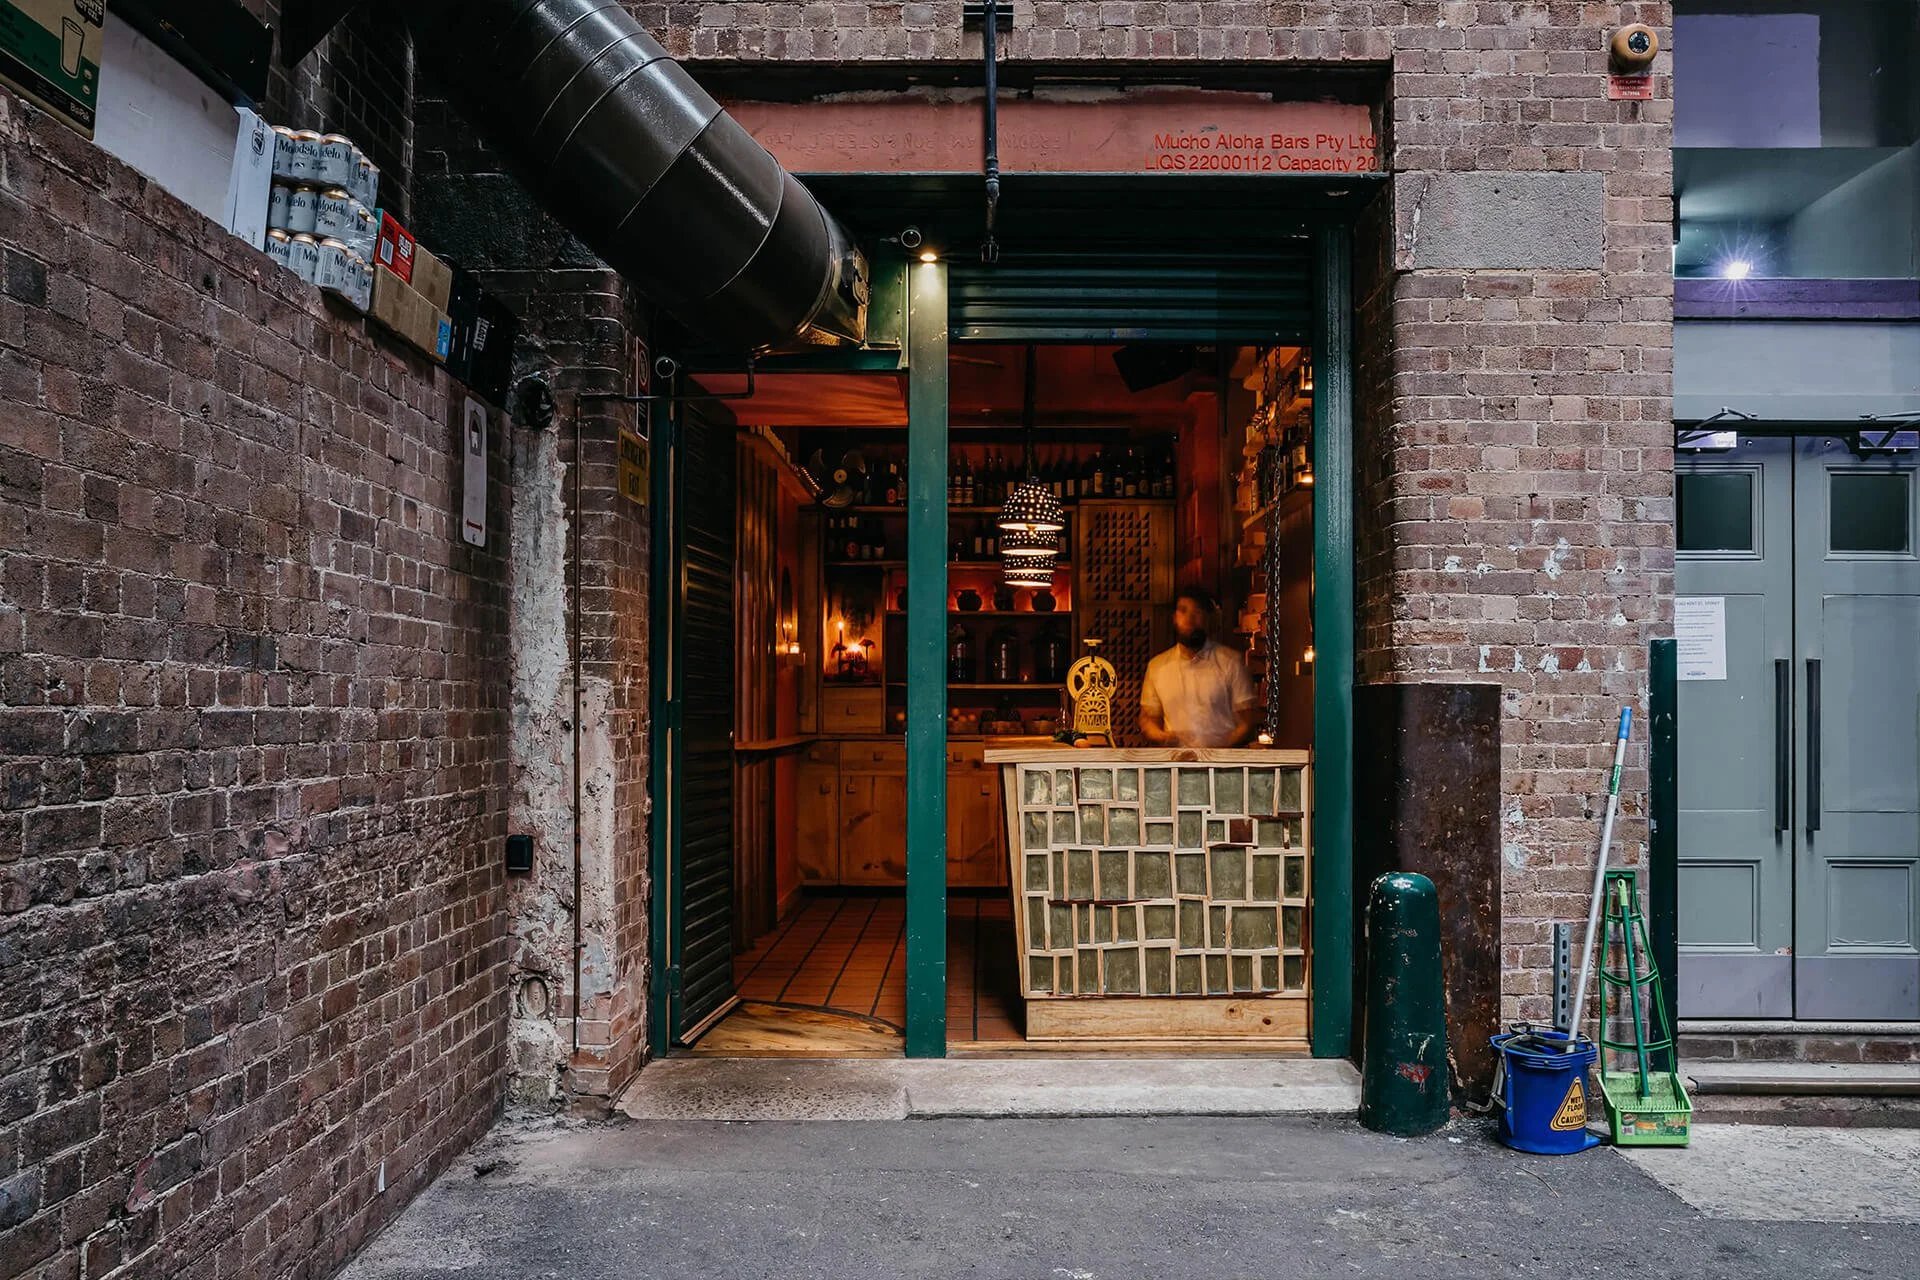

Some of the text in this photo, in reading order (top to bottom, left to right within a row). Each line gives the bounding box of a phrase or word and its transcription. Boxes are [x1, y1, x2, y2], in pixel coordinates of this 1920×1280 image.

[1154, 134, 1377, 153] Mucho Aloha Bars Pty Ltd
[1278, 155, 1351, 172] Capacity
